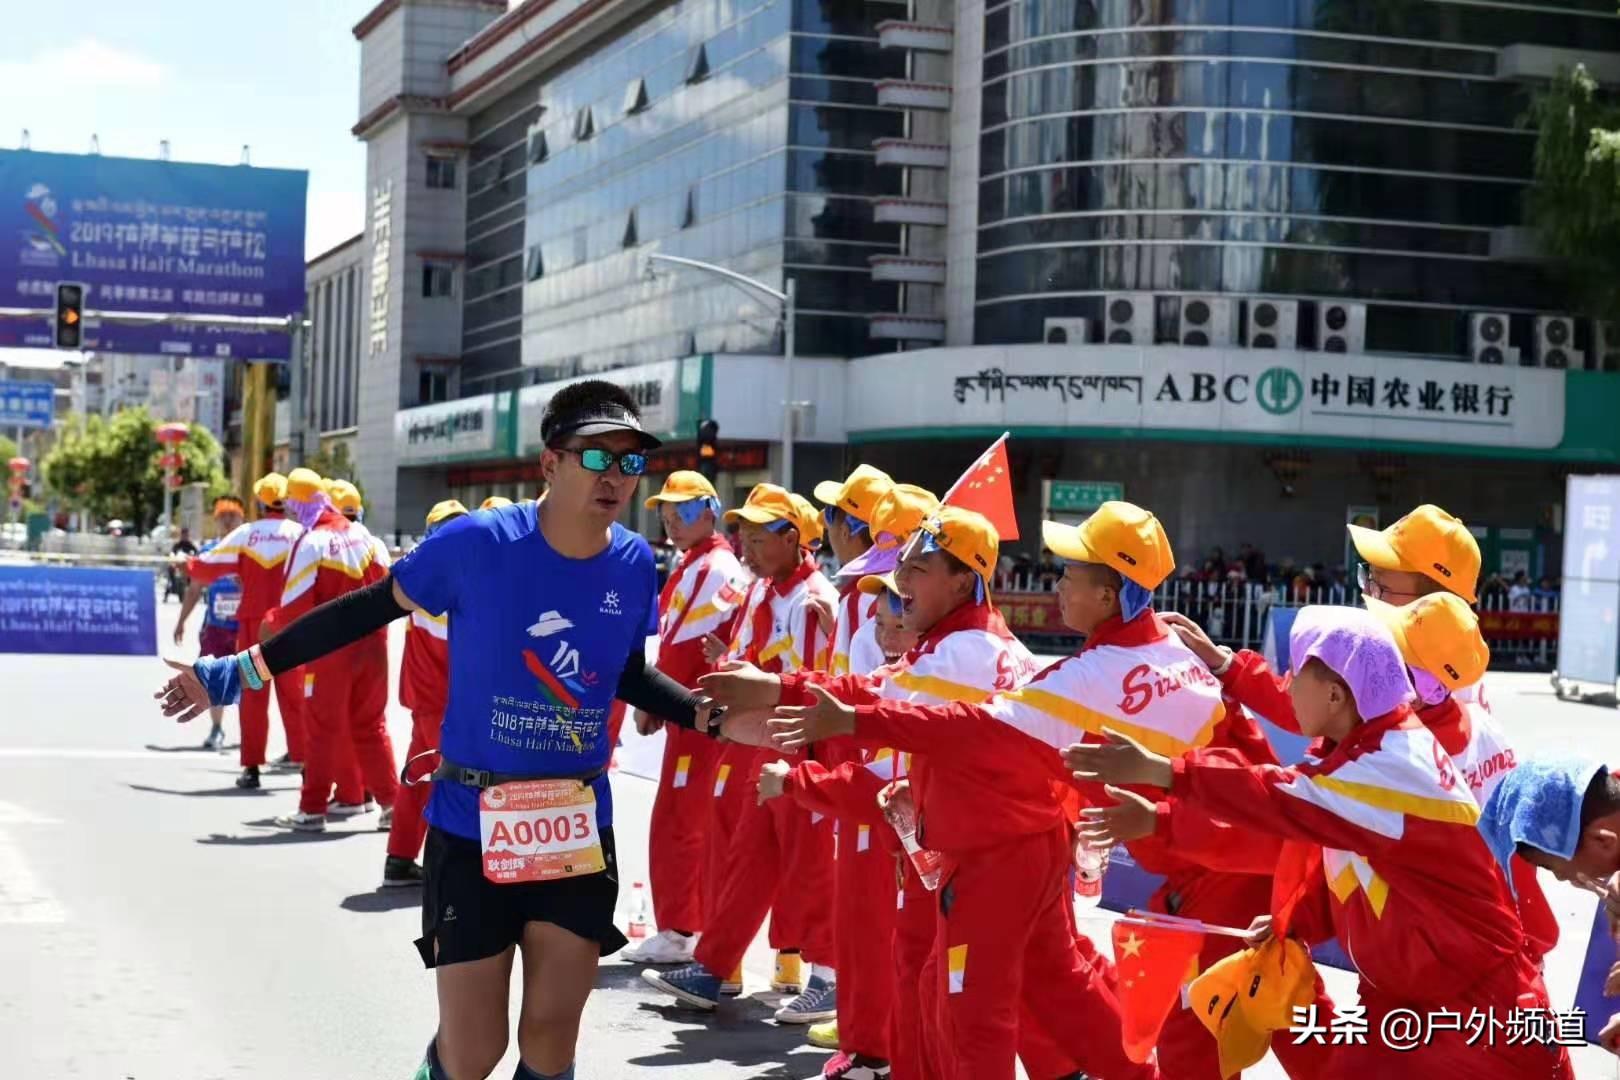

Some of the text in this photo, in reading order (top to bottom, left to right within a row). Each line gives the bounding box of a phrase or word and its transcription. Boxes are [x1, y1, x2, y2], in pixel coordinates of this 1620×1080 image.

[71, 250, 127, 270] Lhasa
[131, 254, 175, 273] Half
[177, 257, 264, 280] Marathon
[1155, 373, 1249, 404] ABC
[1311, 372, 1514, 417] 中国农业银行
[490, 730, 522, 748] Lhasa
[526, 738, 553, 751] Half
[488, 812, 591, 848] A0003
